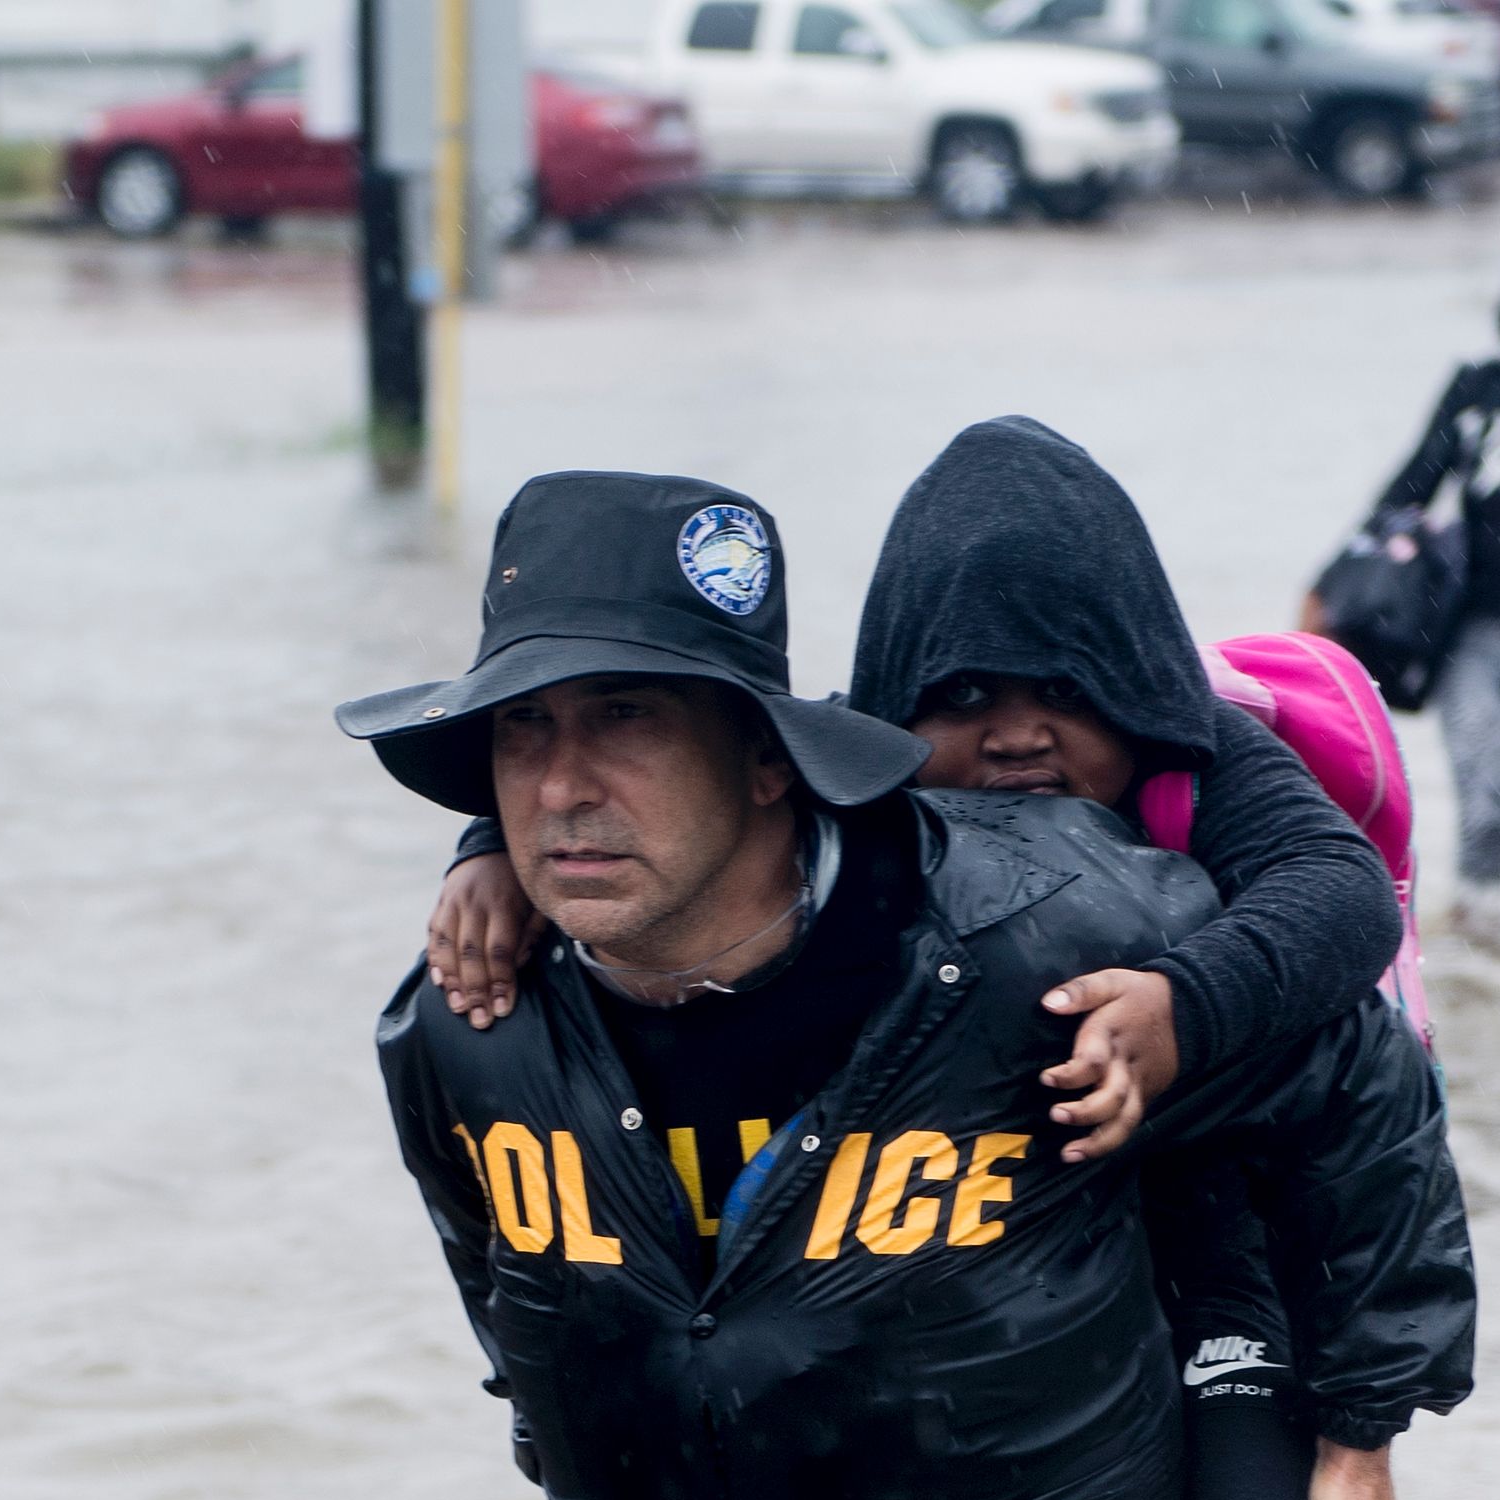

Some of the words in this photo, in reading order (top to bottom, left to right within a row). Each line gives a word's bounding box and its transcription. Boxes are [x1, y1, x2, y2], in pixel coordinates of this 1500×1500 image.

[452, 1120, 623, 1265] OL
[804, 1129, 1032, 1260] ICE
[1195, 1336, 1267, 1364] NIKE
[1198, 1383, 1234, 1399] JUST
[1234, 1383, 1260, 1396] DO
[1260, 1387, 1274, 1397] IT
